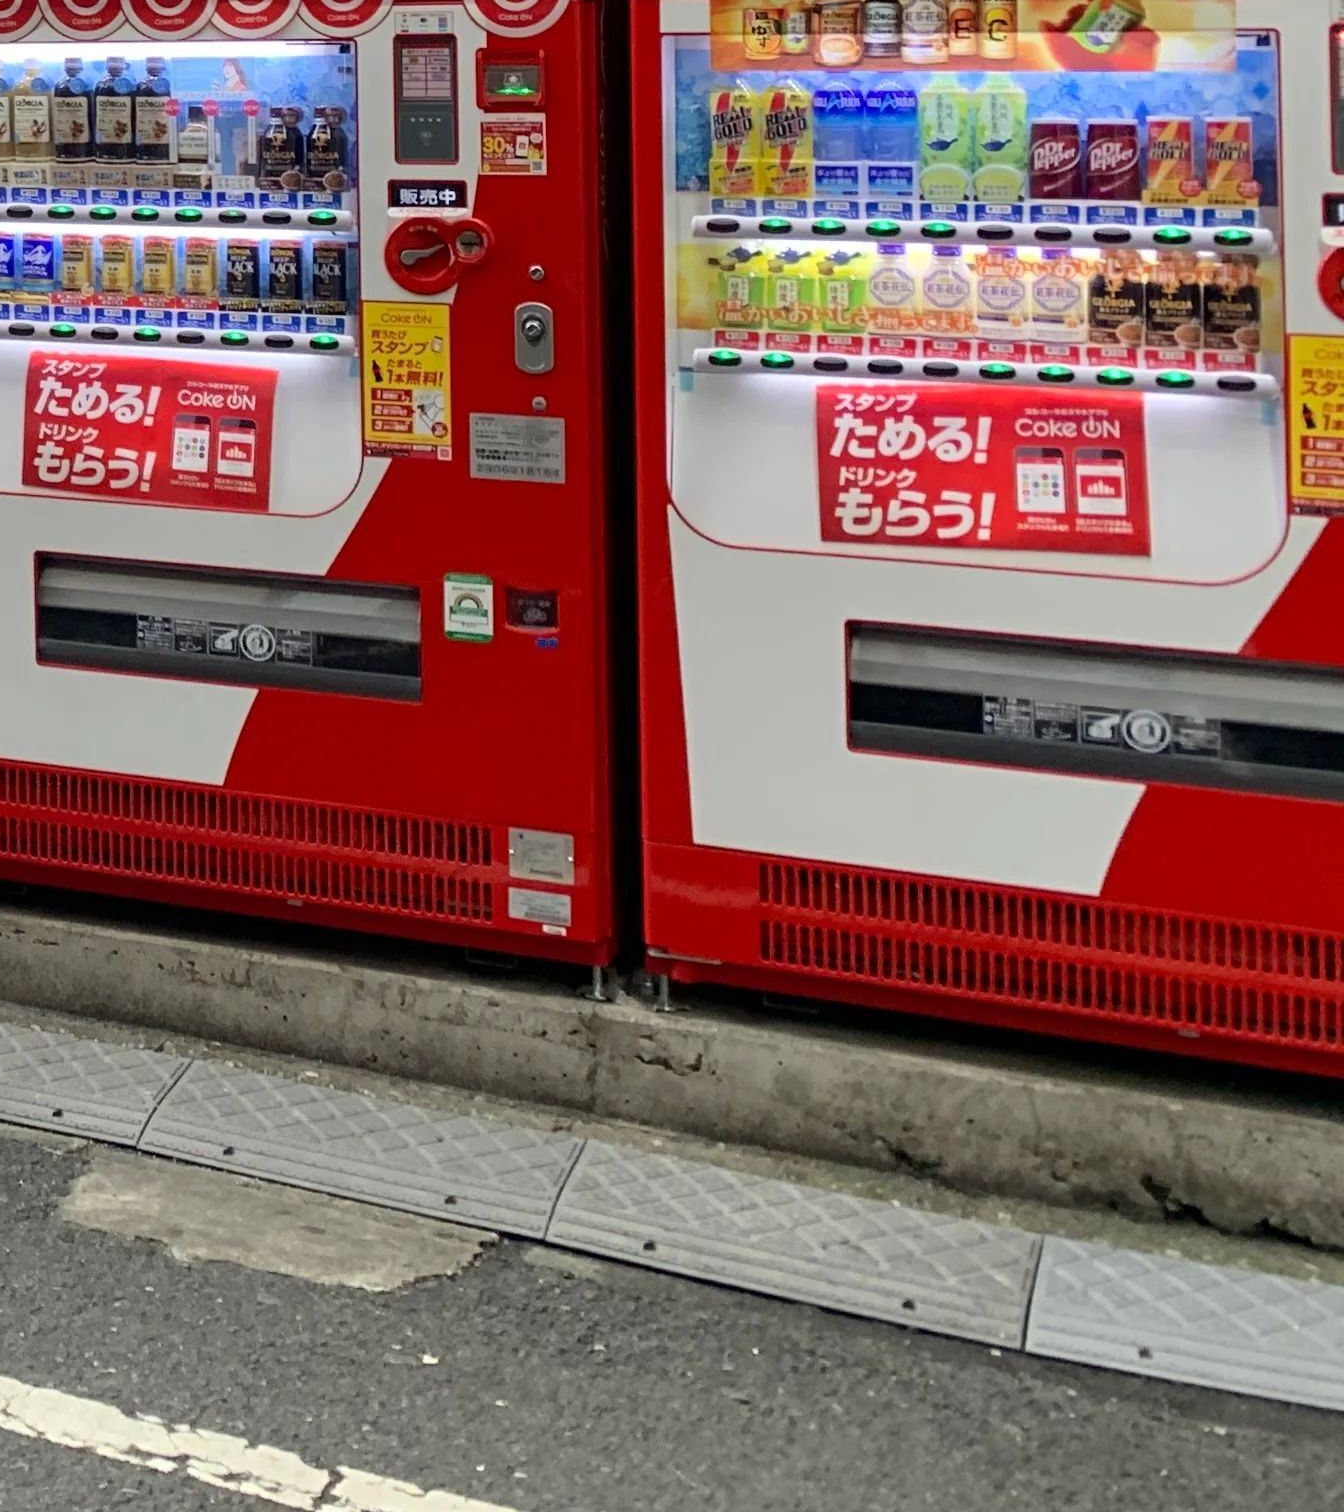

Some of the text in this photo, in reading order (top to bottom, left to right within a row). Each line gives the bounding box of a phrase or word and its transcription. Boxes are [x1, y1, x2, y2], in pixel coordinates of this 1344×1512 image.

[1045, 141, 1066, 155] Dr
[1102, 140, 1123, 155] Dr
[1033, 147, 1077, 171] Pepper
[1090, 147, 1135, 171] Pepper
[400, 189, 456, 205] 販売中
[371, 329, 407, 340] 買うたび
[371, 340, 429, 356] スタンプ
[41, 359, 108, 378] スタンプ
[387, 358, 423, 369] たまると
[387, 368, 444, 387] 1本無料!
[33, 377, 162, 427] ためる!
[177, 389, 256, 411] Coke ON
[834, 393, 919, 413] スタンプ
[38, 422, 100, 443] ドリンク
[1014, 416, 1121, 439] Coke ON
[829, 412, 993, 465] ためる!
[33, 441, 157, 493] もらう!
[838, 466, 918, 488] ドリンク
[834, 487, 996, 541] もらう!
